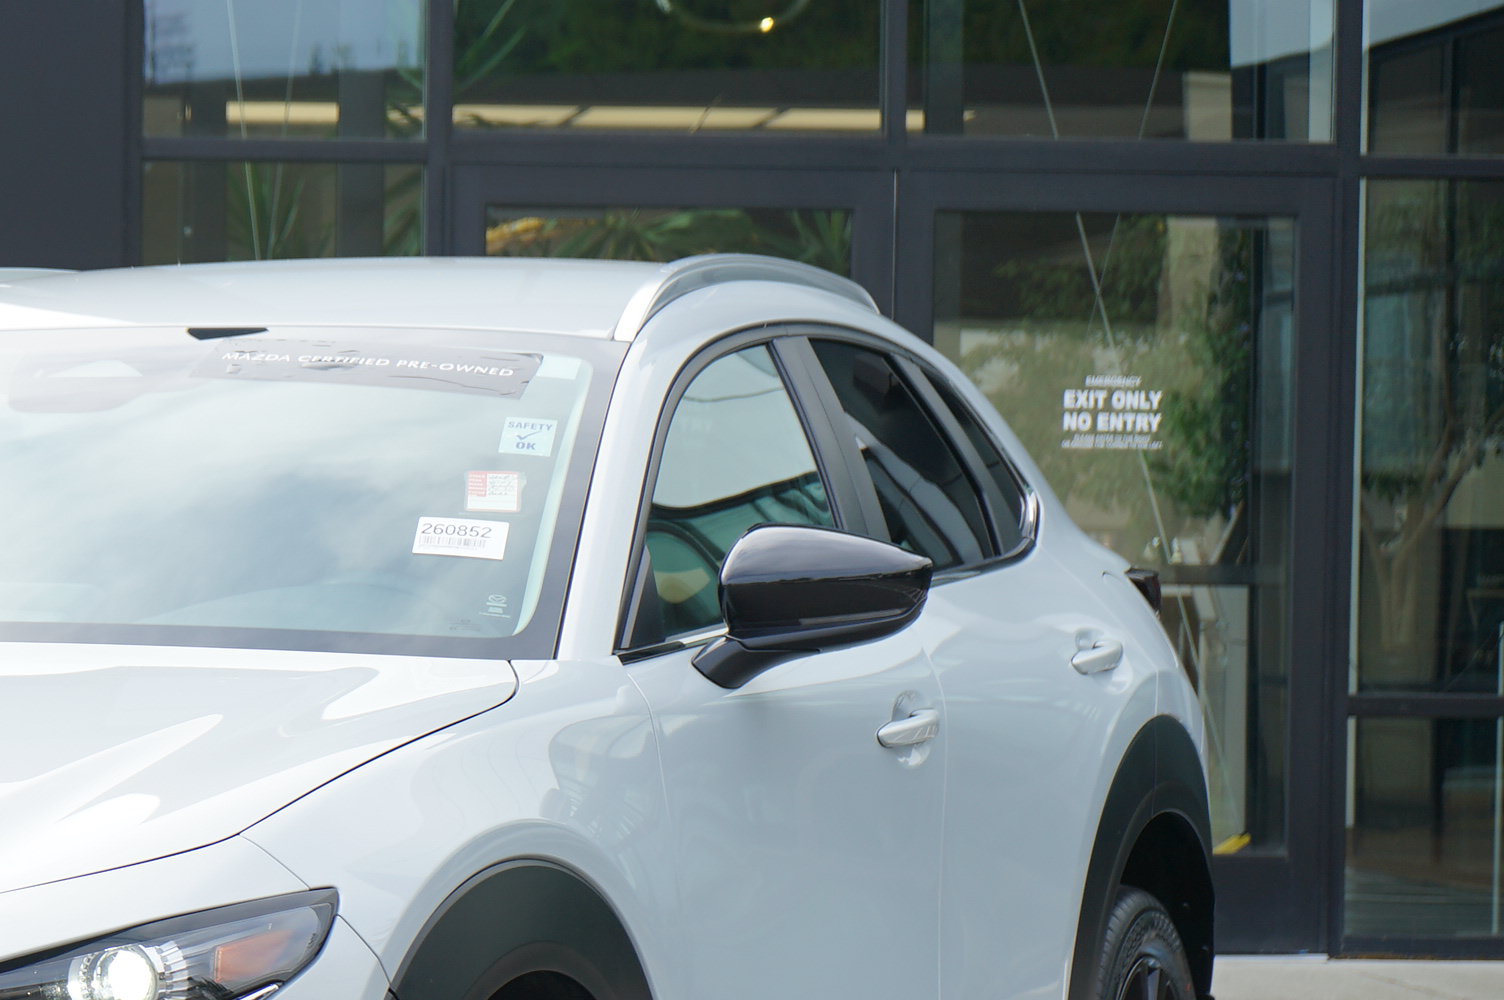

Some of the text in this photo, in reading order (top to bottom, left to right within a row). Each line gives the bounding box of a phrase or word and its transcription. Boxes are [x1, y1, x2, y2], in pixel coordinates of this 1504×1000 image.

[222, 351, 514, 377] MAZDA CERTIFIED PRE-OWNED
[1064, 389, 1162, 409] EXIT ONLY
[508, 421, 553, 431] SAFETY
[1063, 412, 1162, 432] NO ENTRY
[516, 442, 536, 450] OK
[421, 523, 492, 538] 260852
